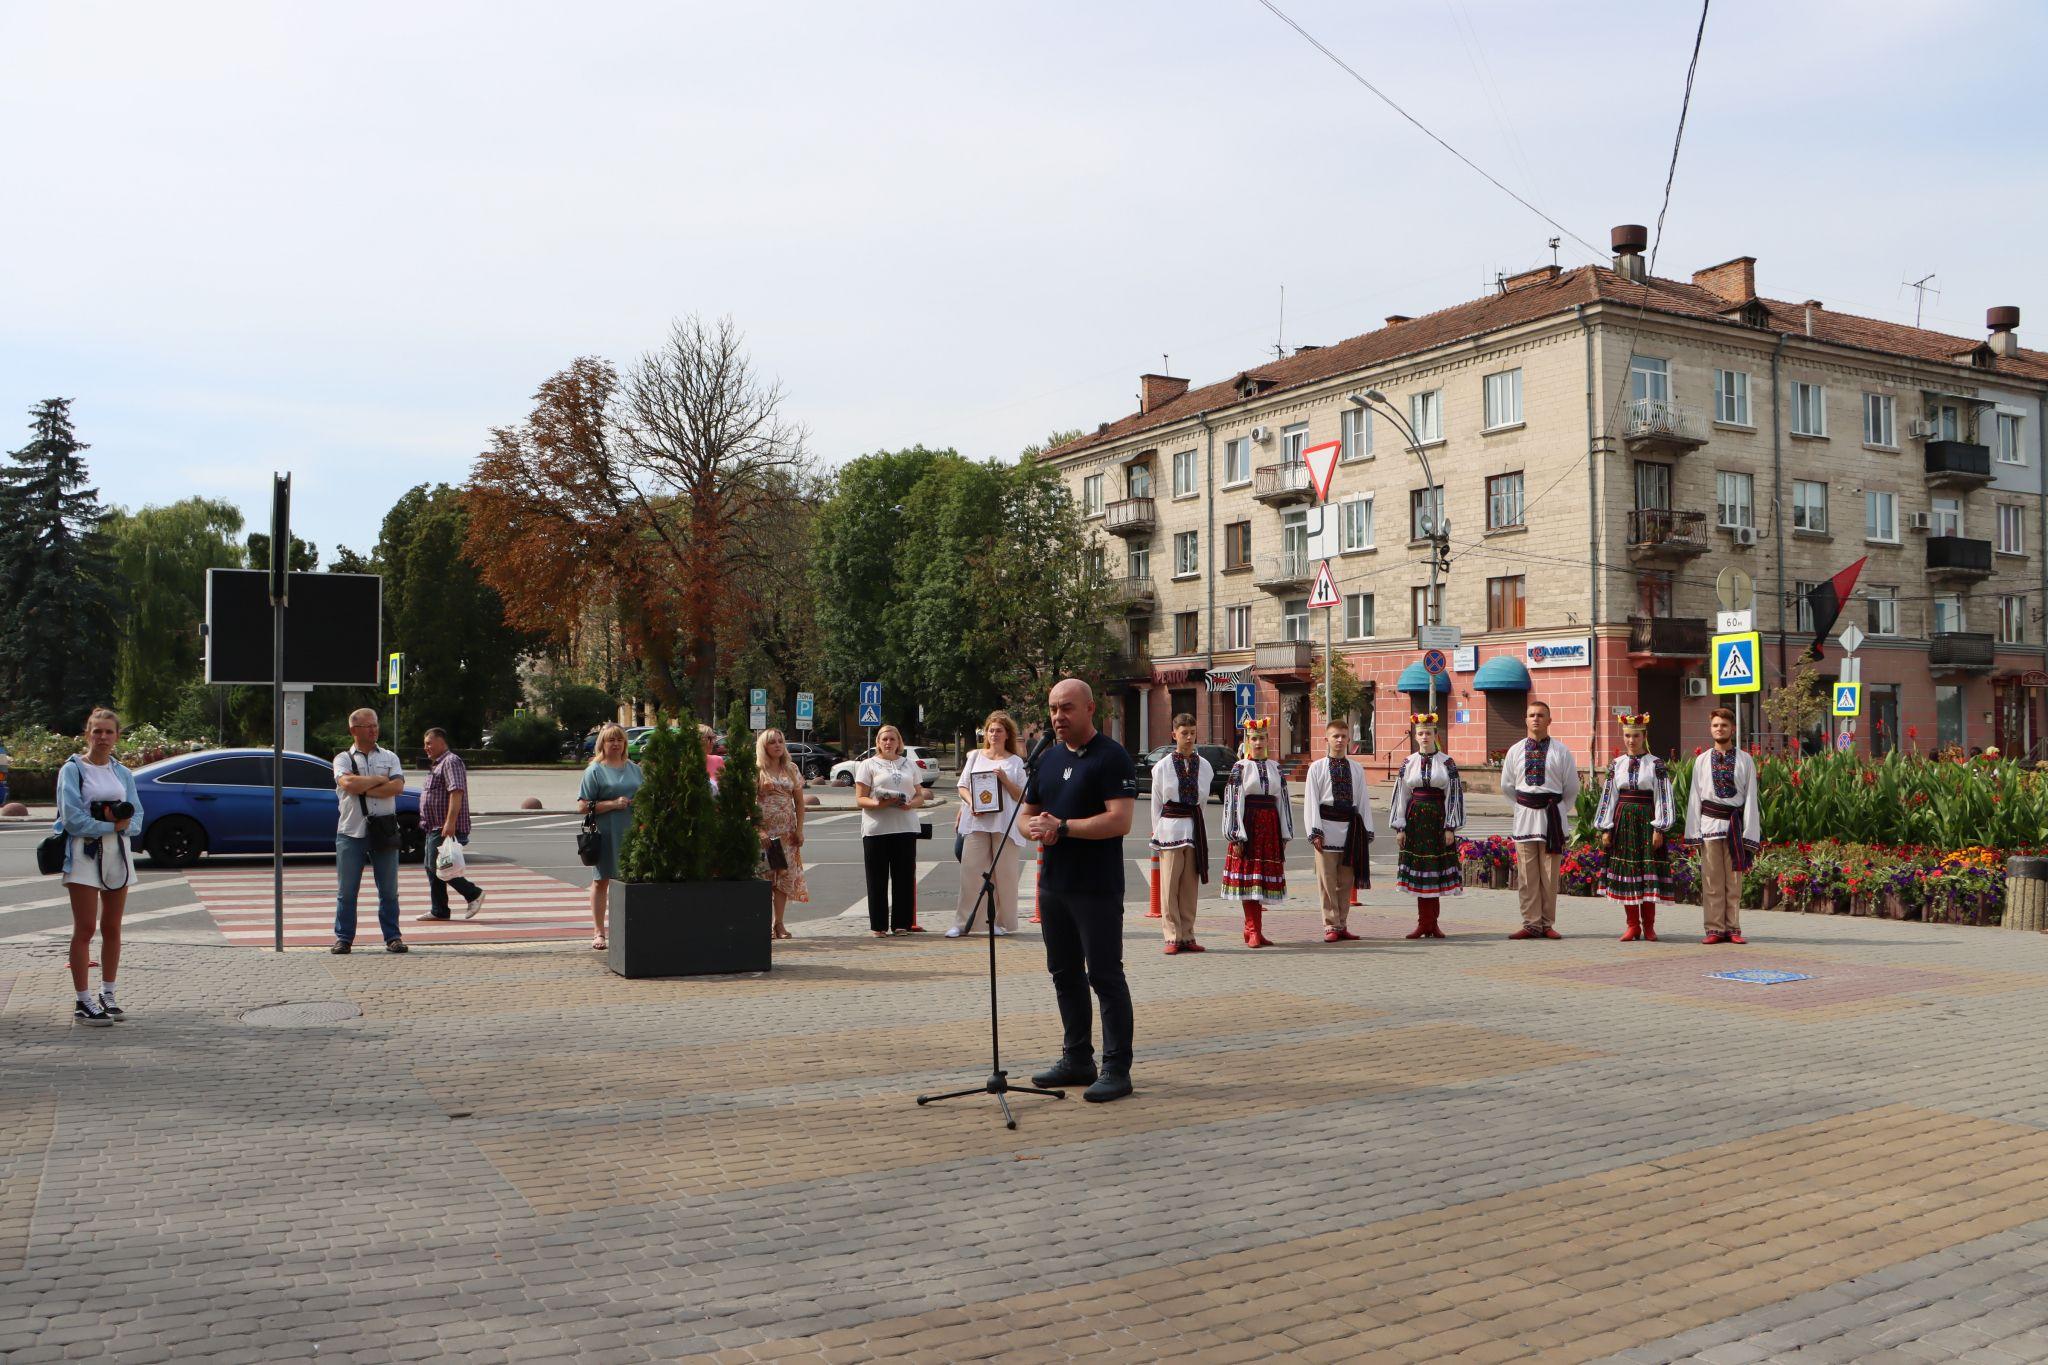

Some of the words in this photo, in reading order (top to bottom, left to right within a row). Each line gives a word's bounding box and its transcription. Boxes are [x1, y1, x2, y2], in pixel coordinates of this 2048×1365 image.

[1528, 645, 1584, 661] КОЛУМБУС
[753, 690, 763, 704] P
[800, 701, 810, 715] P
